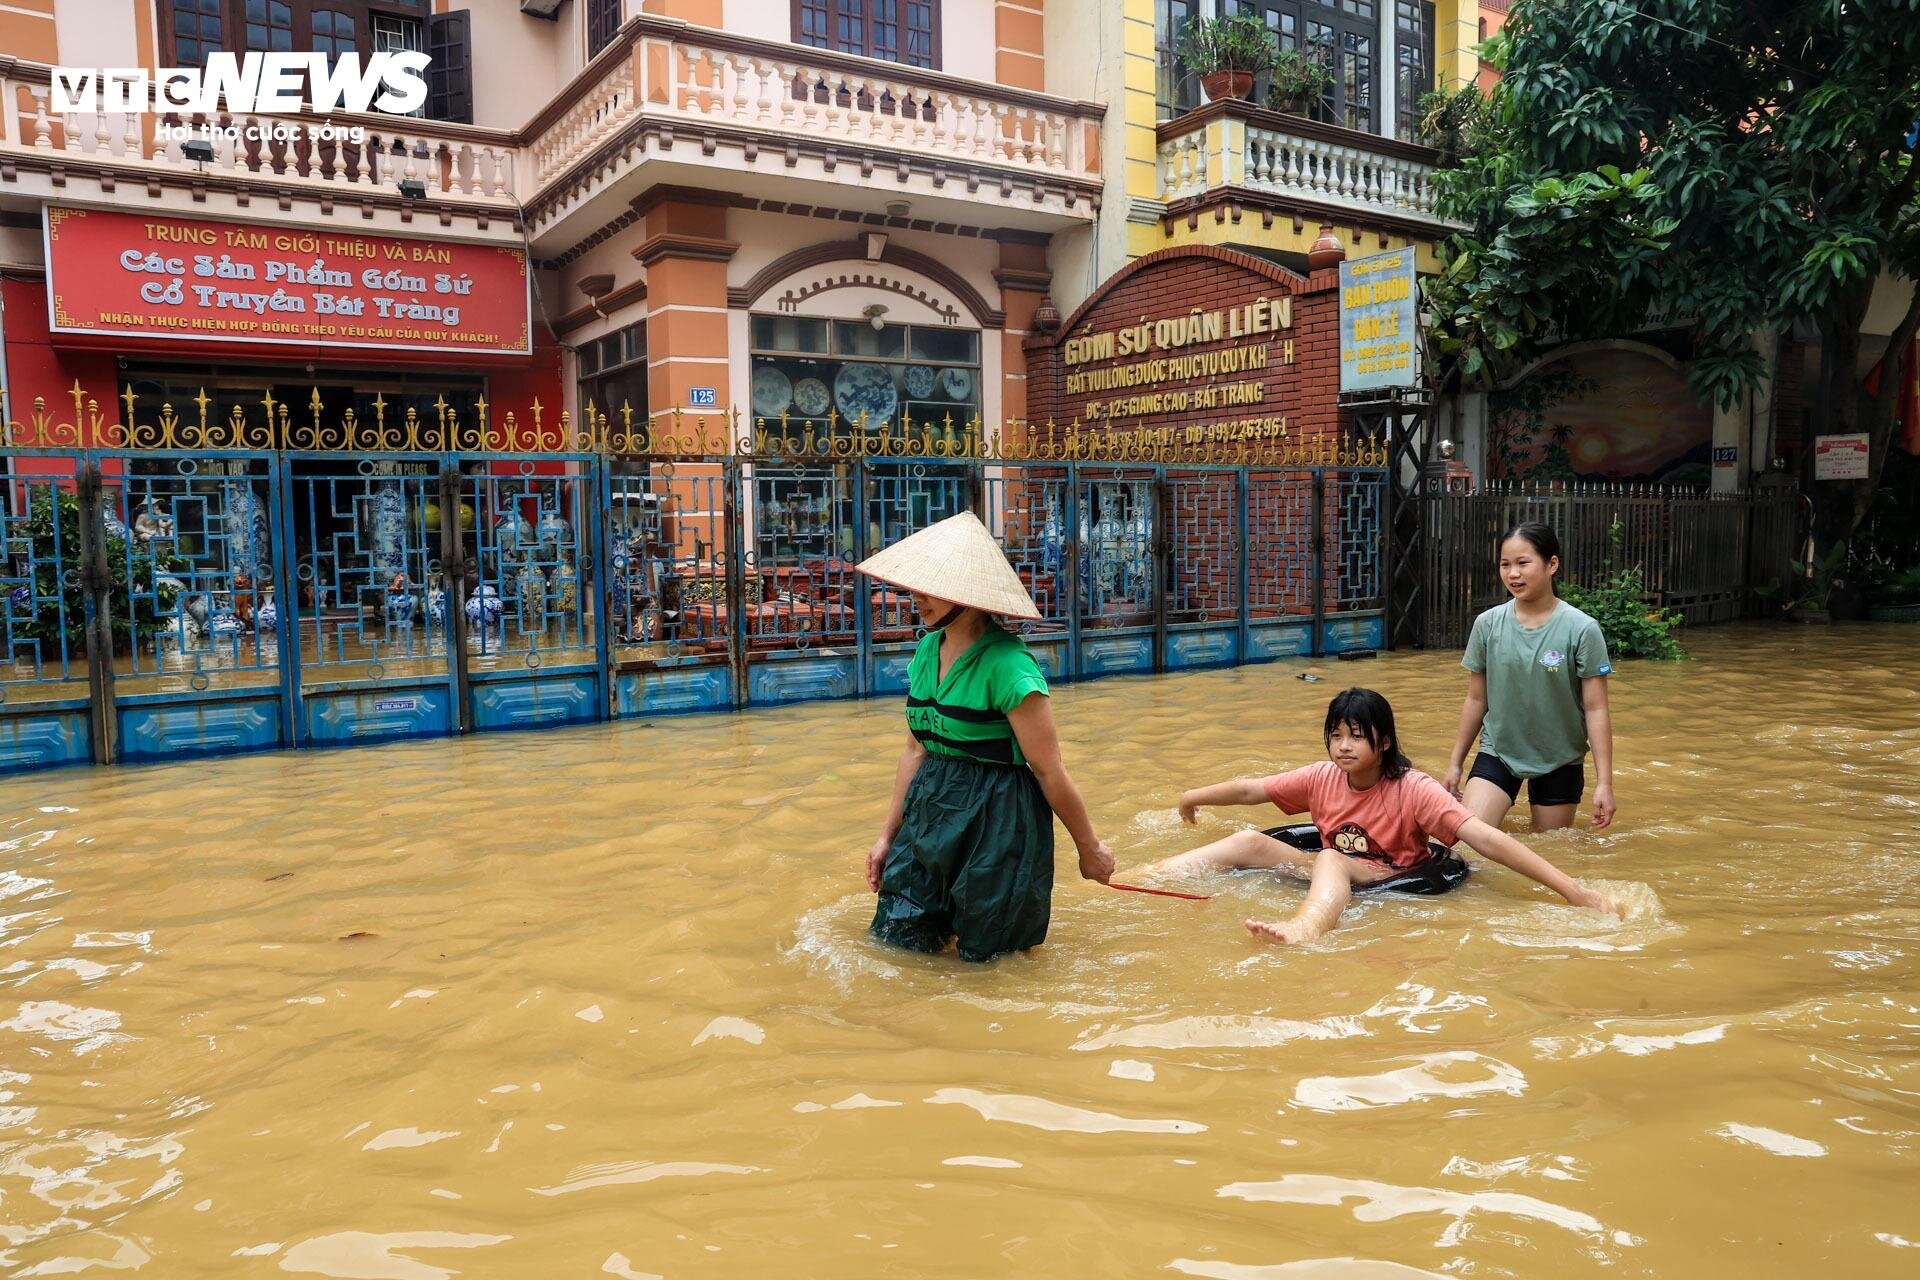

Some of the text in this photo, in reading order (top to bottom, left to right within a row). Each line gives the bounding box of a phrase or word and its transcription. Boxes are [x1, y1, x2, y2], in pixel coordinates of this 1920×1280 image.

[145, 224, 450, 264] TRUNG TÂM GIỚI THIỆU VÀ BÁN
[120, 249, 473, 295] Các Sản Phẩm Gốm Sứ
[140, 278, 460, 326] Cổ Truyền Bát Tràng
[1344, 275, 1409, 309] BÁN BUÔN
[100, 312, 144, 327] NHẬN
[149, 315, 188, 330] THỰC
[192, 317, 226, 332] HIỆN
[229, 320, 258, 334] HỢP
[261, 319, 299, 334] ĐỒNG
[303, 324, 336, 336] THEO
[340, 324, 365, 337] YÊU
[396, 326, 421, 339] CỦA
[424, 328, 448, 342] QUÝ
[1065, 297, 1293, 366] GỐM SỨ QUÂN LIÊN
[1355, 314, 1380, 341] BÁN
[1066, 366, 1086, 394] RẤT
[1088, 373, 1106, 391] VUI
[1106, 362, 1135, 388] LÒNG
[1135, 359, 1167, 388] ĐƯỢC
[1168, 355, 1201, 383] PHỤC
[1201, 352, 1219, 381] VỤ
[1220, 341, 1247, 373] QUÝ
[693, 390, 714, 403] 125
[1108, 400, 1128, 417] 125
[1128, 393, 1163, 415] GIANG
[1163, 392, 1188, 411] CAO
[1194, 384, 1218, 409] BÁT
[1715, 448, 1736, 461] 127
